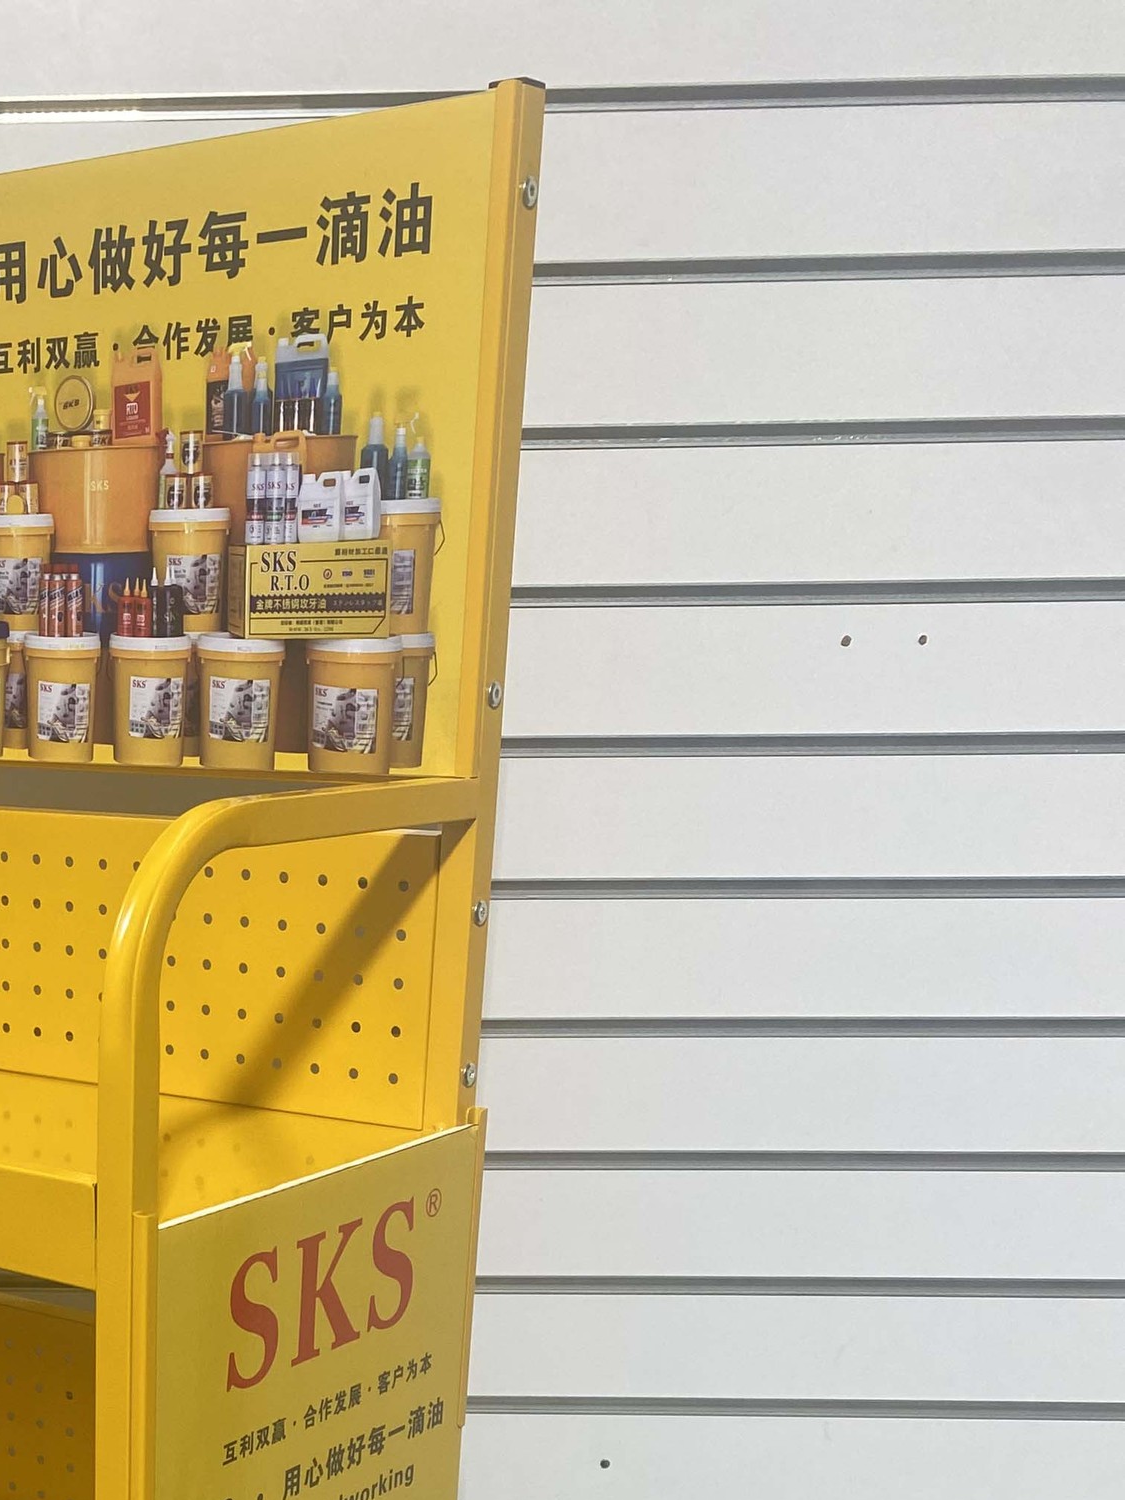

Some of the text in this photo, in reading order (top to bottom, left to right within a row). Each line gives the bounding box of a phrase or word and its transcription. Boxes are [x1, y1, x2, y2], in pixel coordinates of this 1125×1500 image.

[90, 479, 109, 491] SKS
[260, 551, 297, 573] SKS
[270, 574, 310, 591] R.T.O
[226, 1196, 416, 1392] SKS
